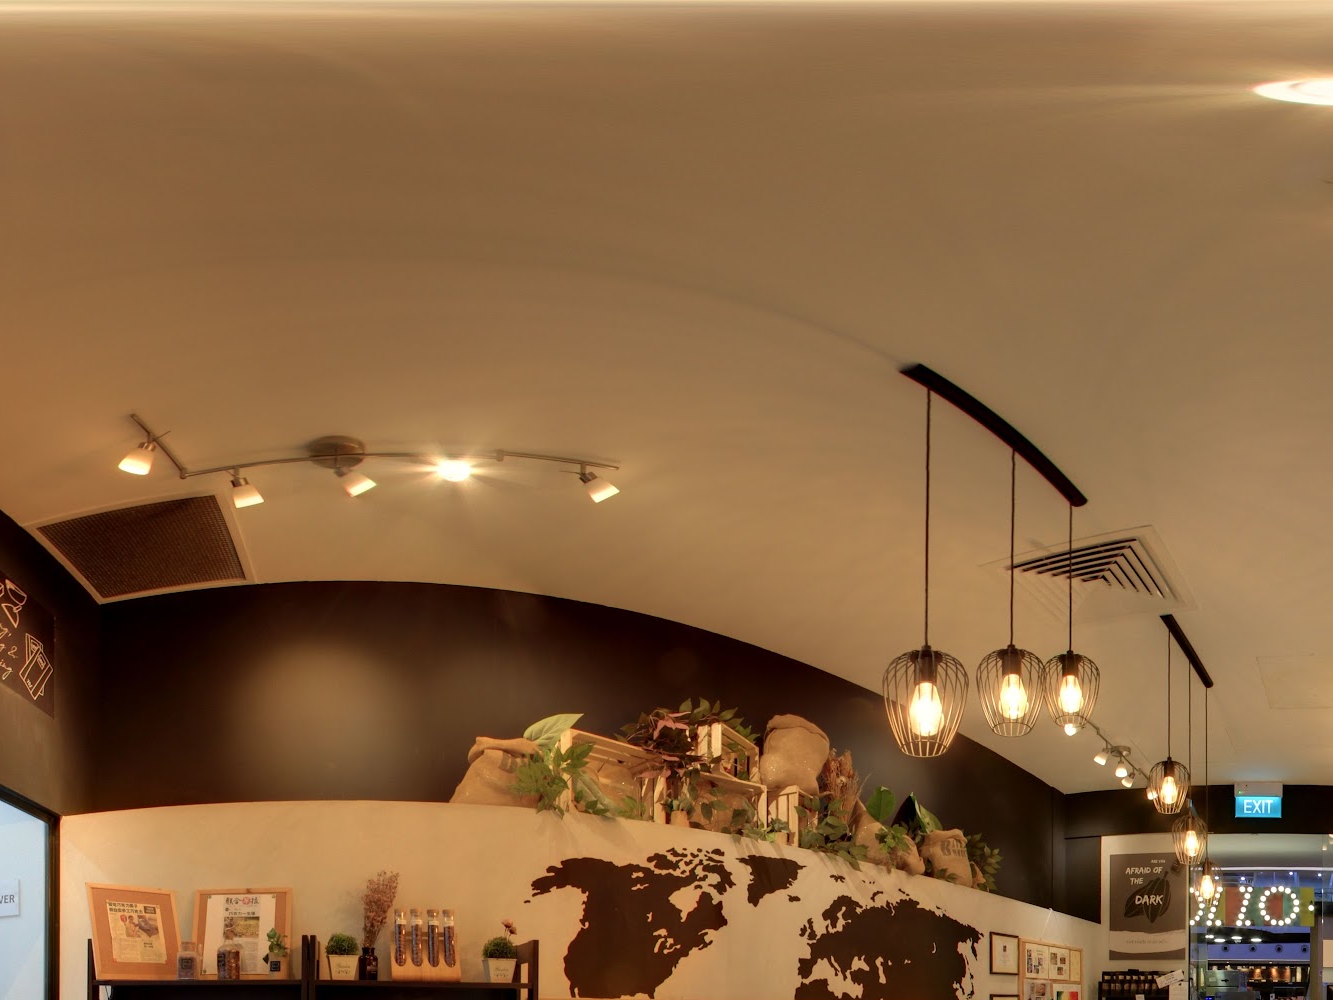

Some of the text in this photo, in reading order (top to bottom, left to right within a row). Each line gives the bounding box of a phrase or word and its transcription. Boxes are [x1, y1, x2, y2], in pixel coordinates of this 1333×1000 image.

[7, 645, 18, 659] &
[1244, 799, 1273, 814] EXIT
[1125, 866, 1163, 875] AFRAID OF
[1129, 877, 1144, 885] THE
[1134, 894, 1164, 906] DARK
